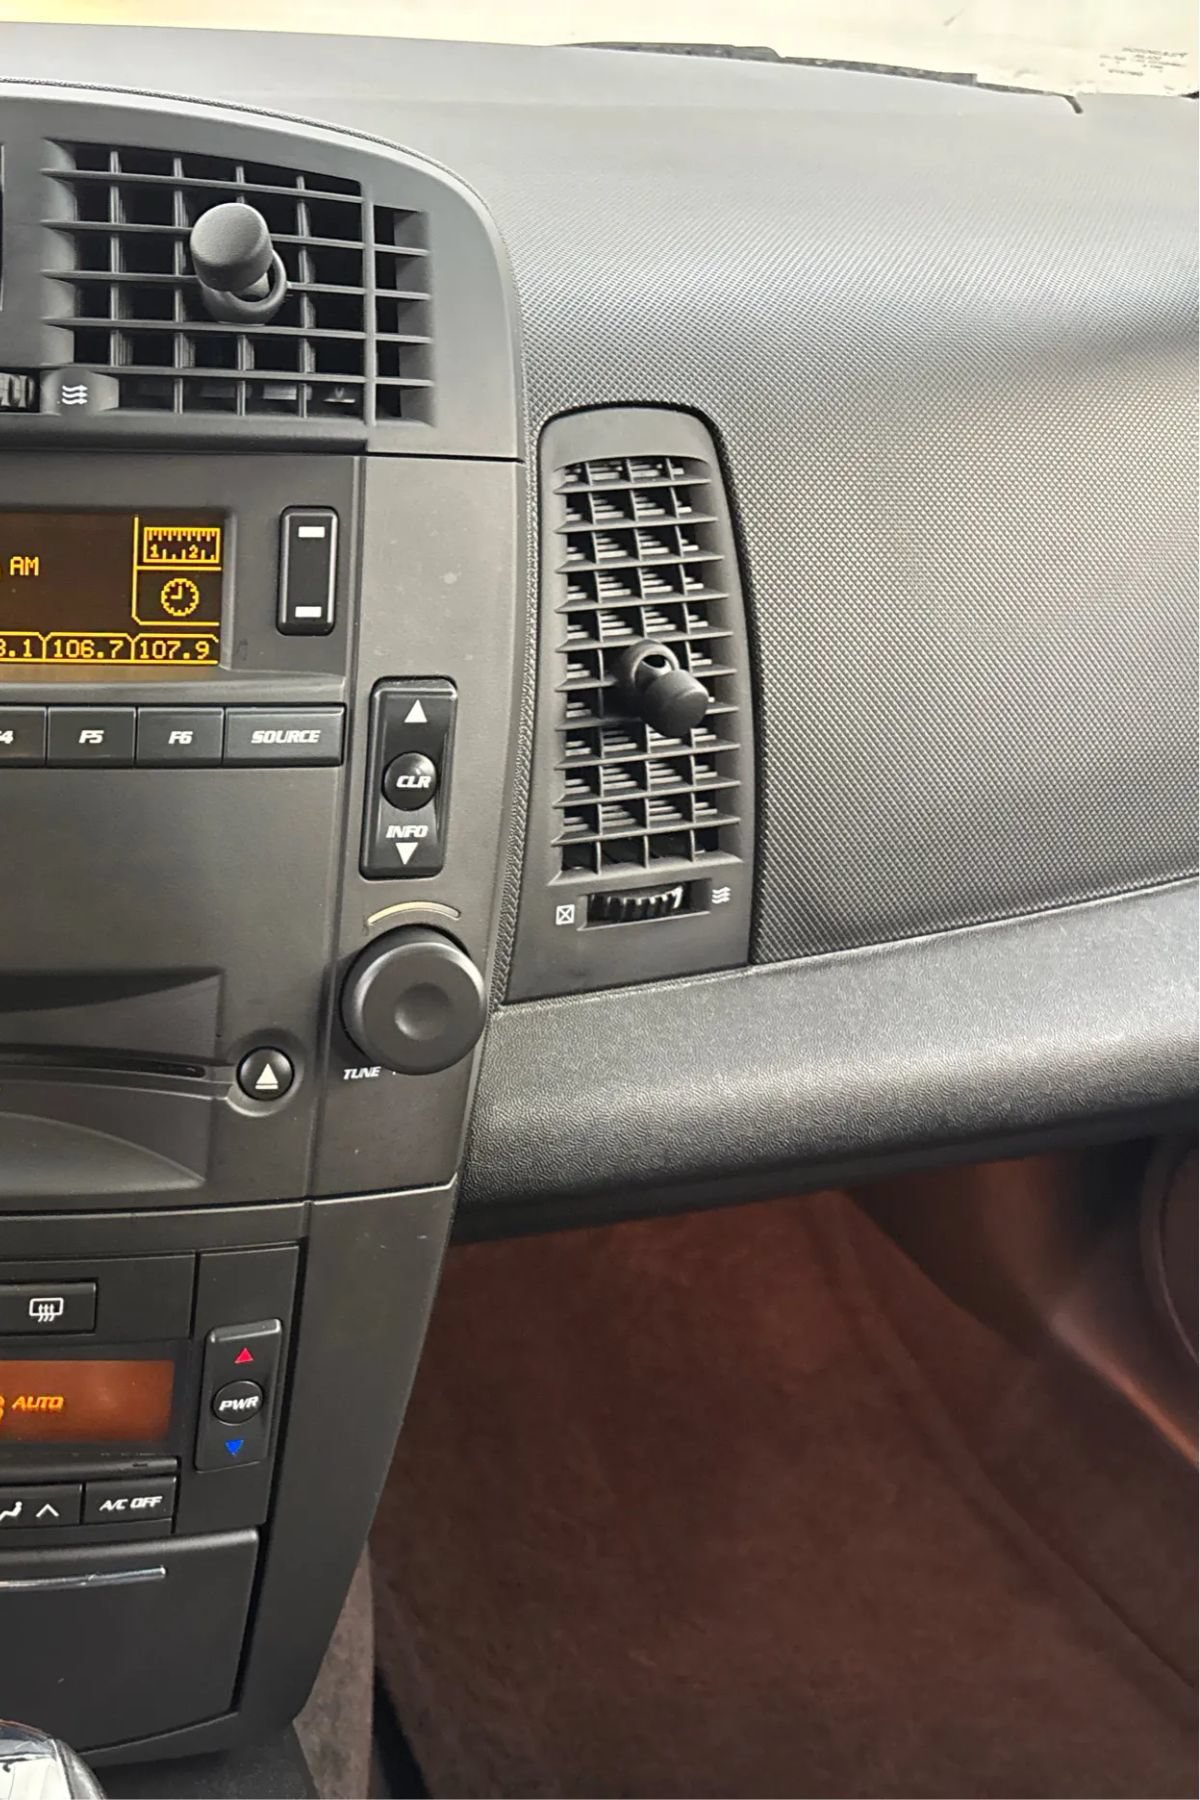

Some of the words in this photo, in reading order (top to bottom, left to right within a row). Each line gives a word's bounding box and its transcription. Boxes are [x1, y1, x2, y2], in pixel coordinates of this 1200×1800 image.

[9, 556, 39, 576] AM
[52, 639, 122, 659] 106.7
[139, 640, 210, 660] 107.9
[78, 729, 105, 744] F5
[168, 730, 194, 745] F6
[250, 729, 321, 744] SOURCE
[396, 775, 431, 790] CLR
[385, 824, 429, 839] INFO
[343, 1066, 382, 1080] TUNE
[11, 1395, 64, 1411] AUTO
[220, 1395, 259, 1412] PWR
[99, 1498, 129, 1511] A/C
[126, 1495, 163, 1509] OFF
